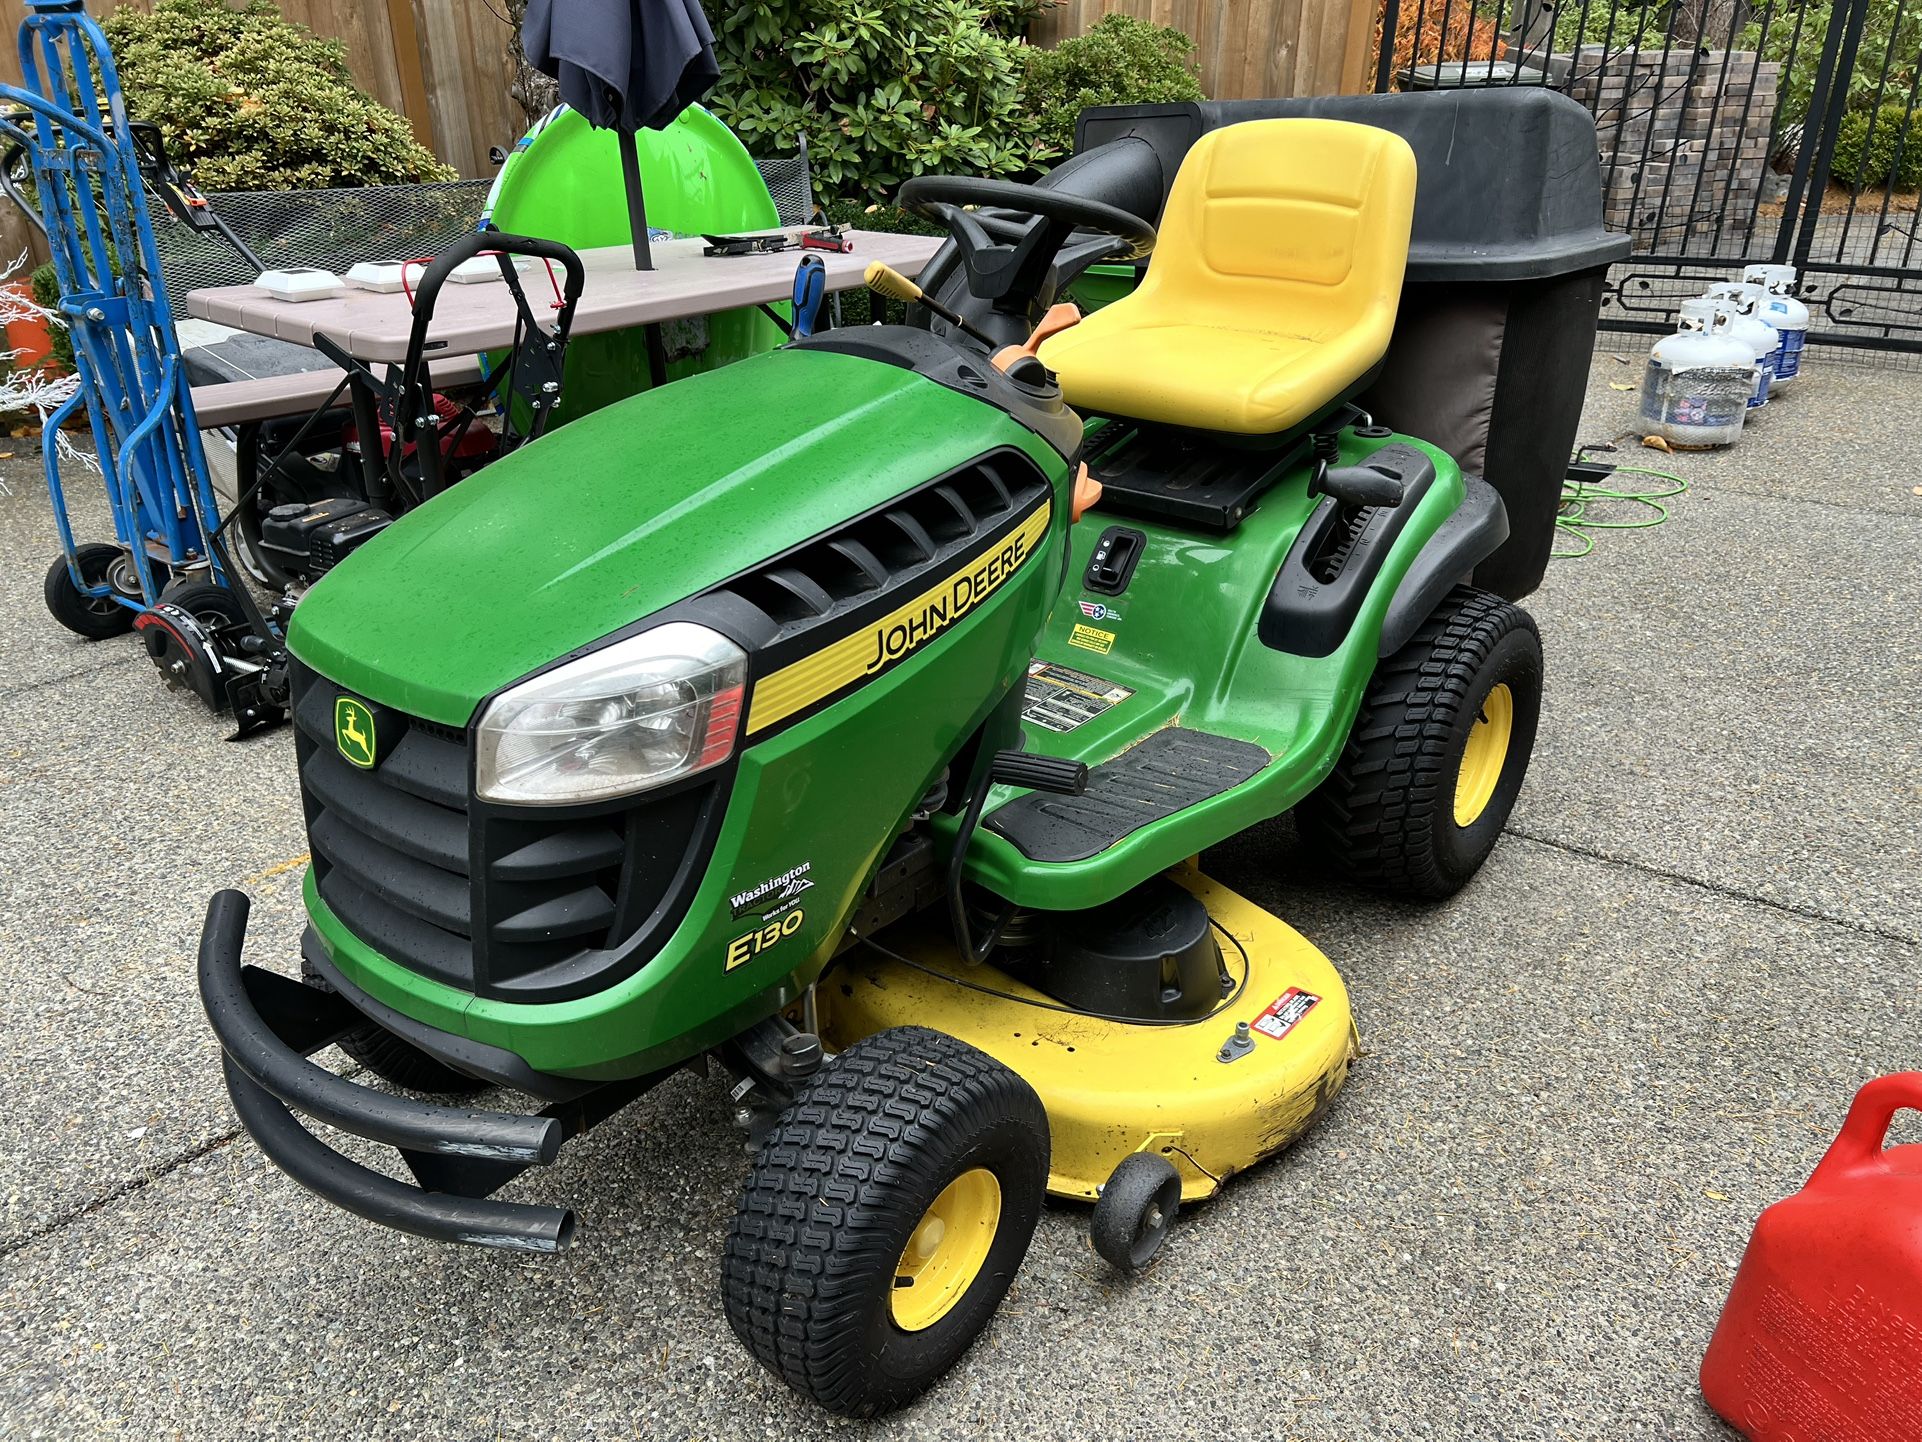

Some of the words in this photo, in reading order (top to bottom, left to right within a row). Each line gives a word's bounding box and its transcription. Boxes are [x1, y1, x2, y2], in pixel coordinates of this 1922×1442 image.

[866, 595, 948, 672] JOHN
[953, 531, 1027, 614] DEERE
[1078, 625, 1110, 640] NOTICE
[730, 861, 811, 908] Washington
[732, 886, 784, 917] TRACTOR
[762, 908, 780, 921] Works
[779, 904, 789, 913] for
[725, 909, 804, 972] E130
